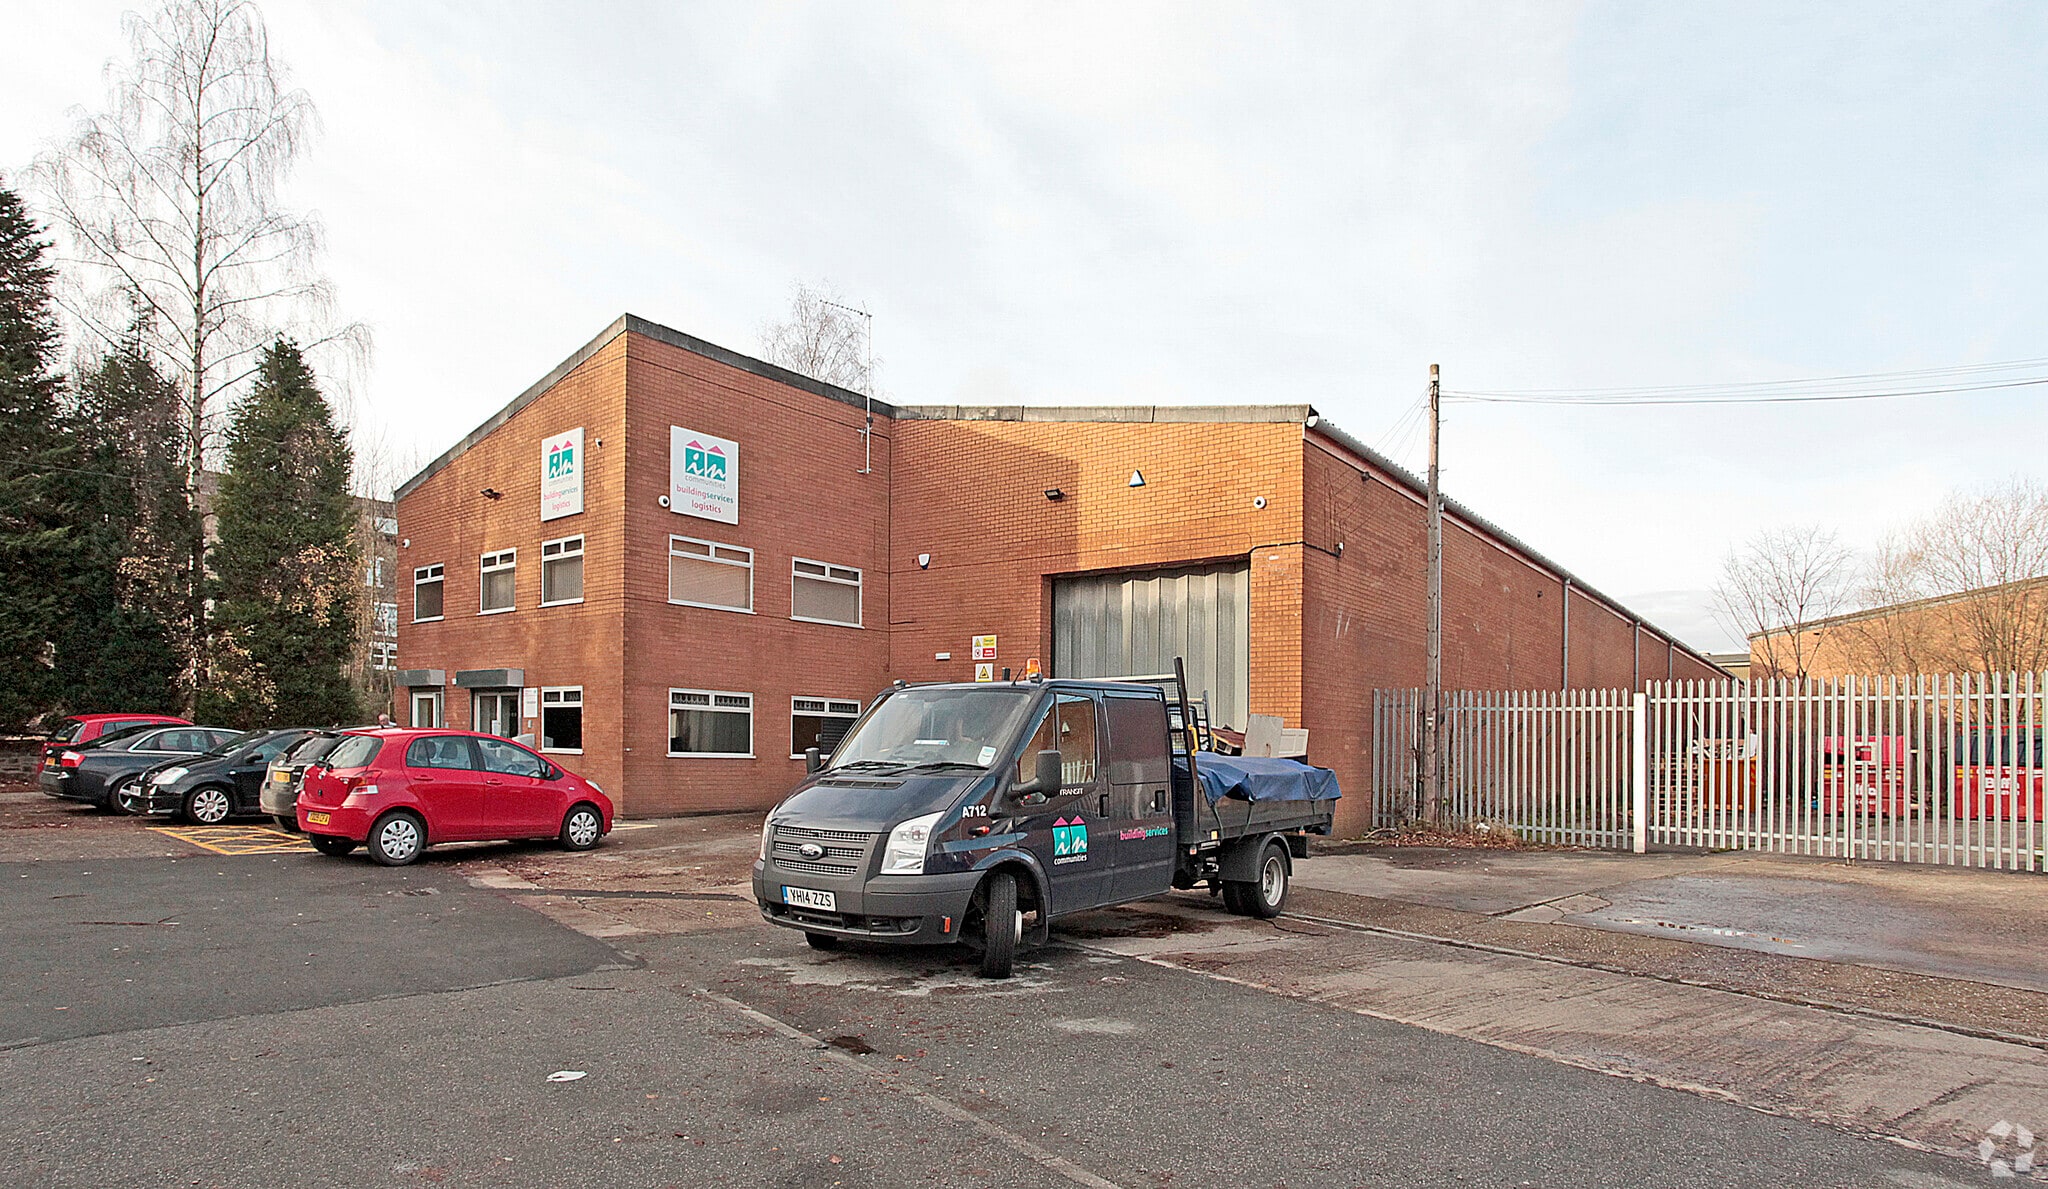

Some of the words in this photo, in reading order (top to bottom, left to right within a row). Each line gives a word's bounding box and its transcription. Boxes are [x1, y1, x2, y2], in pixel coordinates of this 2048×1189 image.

[685, 475, 726, 489] communities
[676, 483, 734, 503] buildingservices
[692, 500, 722, 513] logistics
[1060, 787, 1083, 796] TRANSIT
[962, 804, 987, 818] A712
[1054, 854, 1087, 865] communities
[790, 889, 811, 904] YH14
[812, 892, 832, 907] ZZS
